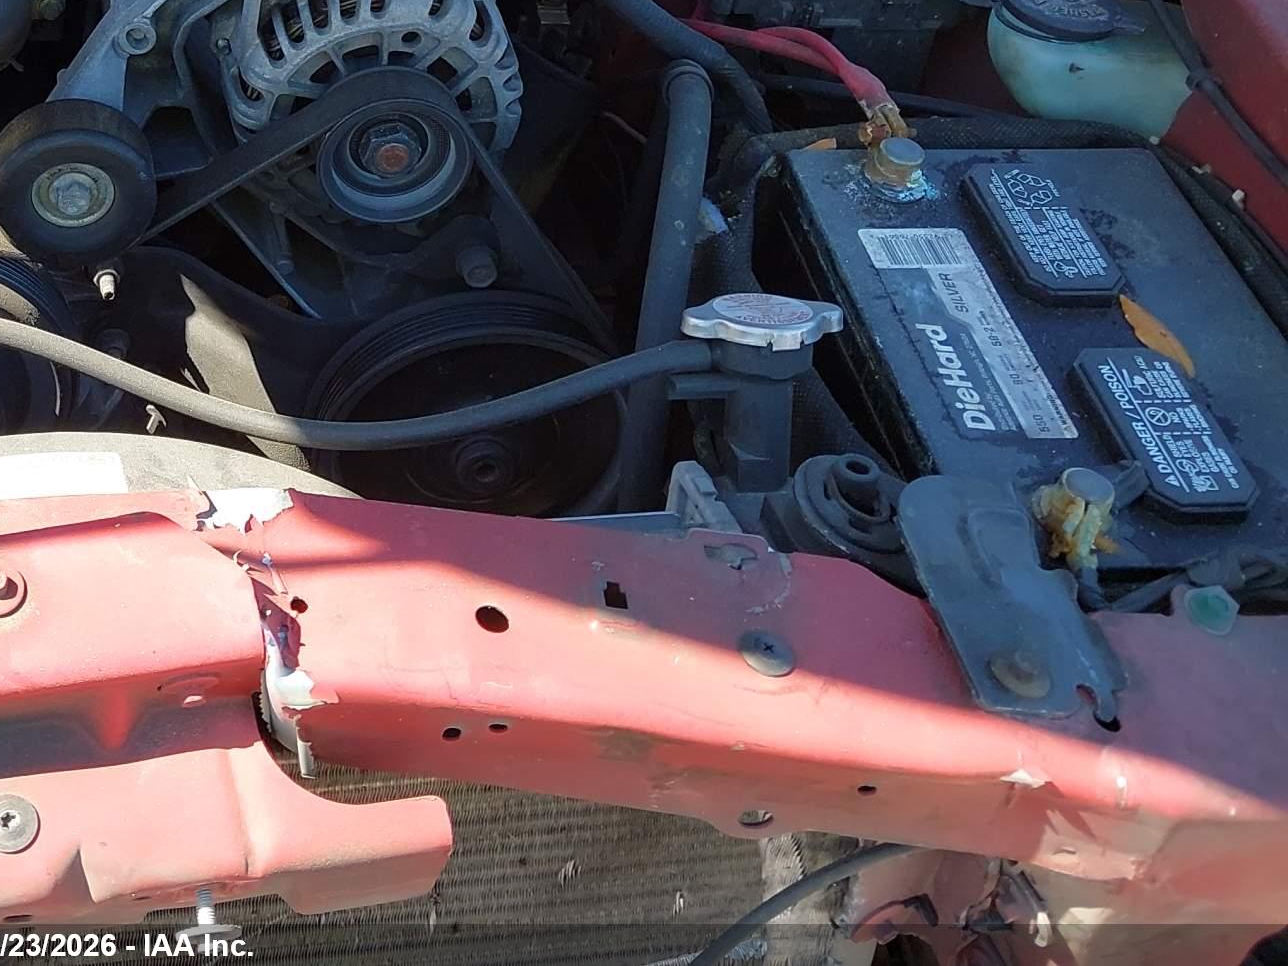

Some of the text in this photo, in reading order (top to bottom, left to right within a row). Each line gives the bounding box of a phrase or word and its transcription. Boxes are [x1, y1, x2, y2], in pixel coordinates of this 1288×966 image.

[938, 272, 969, 314] SILVER
[915, 323, 996, 431] DieHard
[1097, 365, 1134, 410] POISON
[1132, 421, 1172, 473] DANGER
